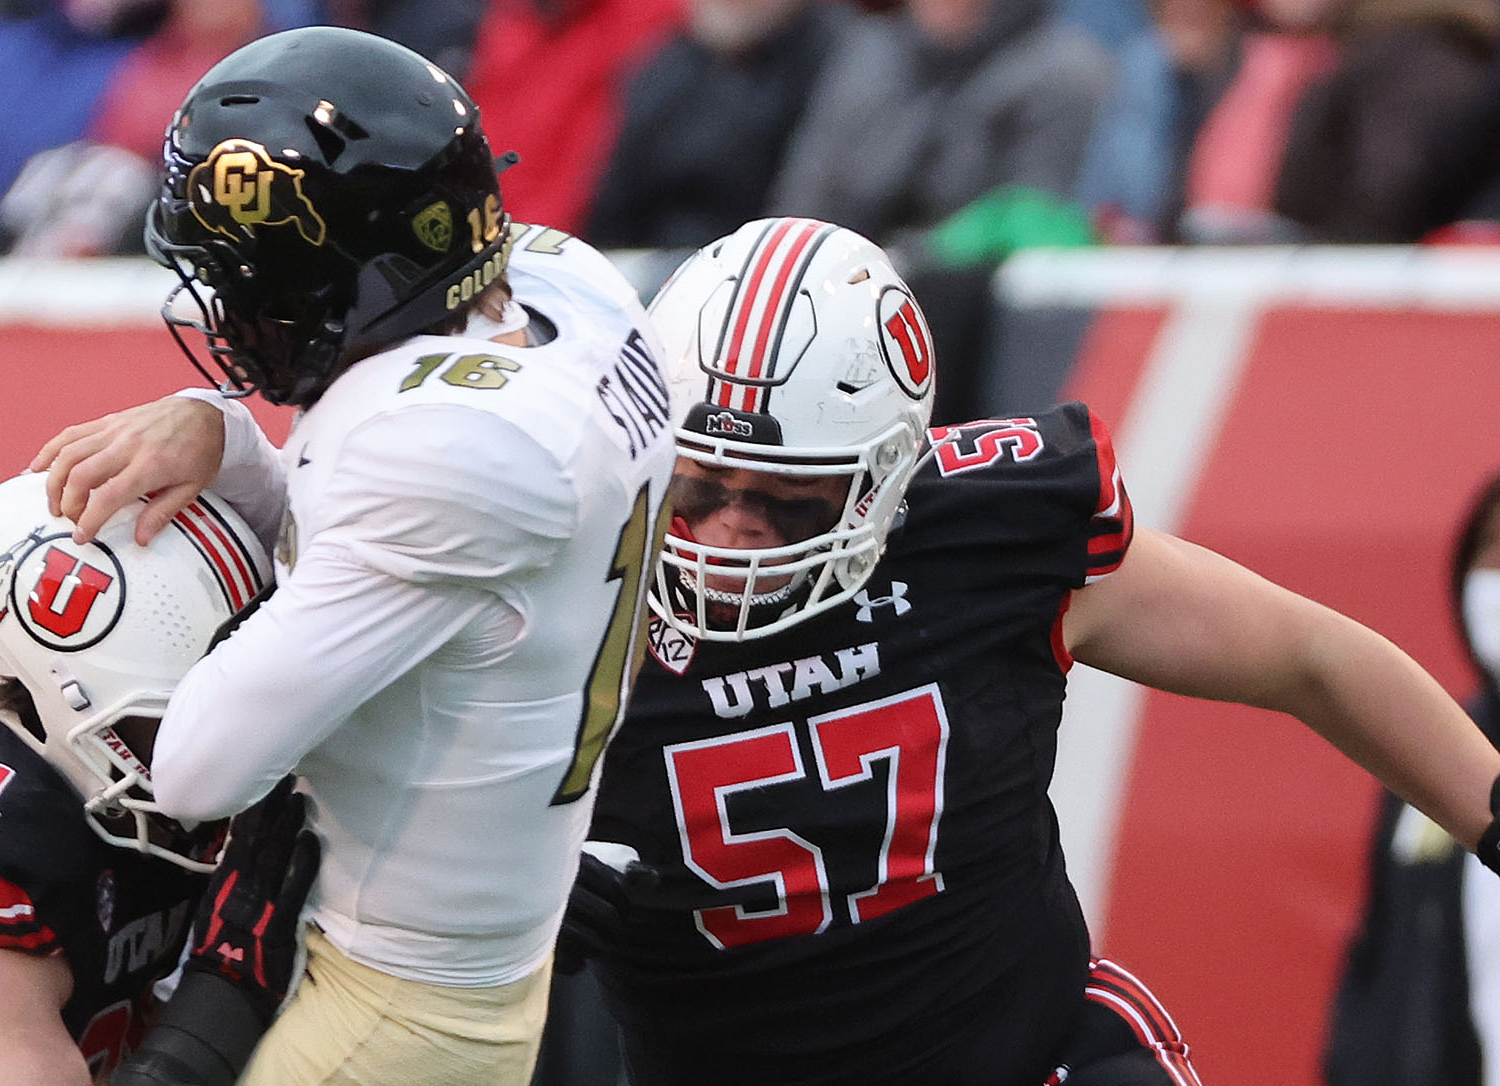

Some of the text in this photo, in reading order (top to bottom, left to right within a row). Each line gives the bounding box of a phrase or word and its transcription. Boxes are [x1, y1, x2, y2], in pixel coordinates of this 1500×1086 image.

[214, 151, 274, 224] CU
[397, 351, 522, 394] 16
[884, 298, 930, 387] U
[27, 545, 114, 639] U
[702, 642, 881, 719] UTAH
[662, 682, 951, 950] 57
